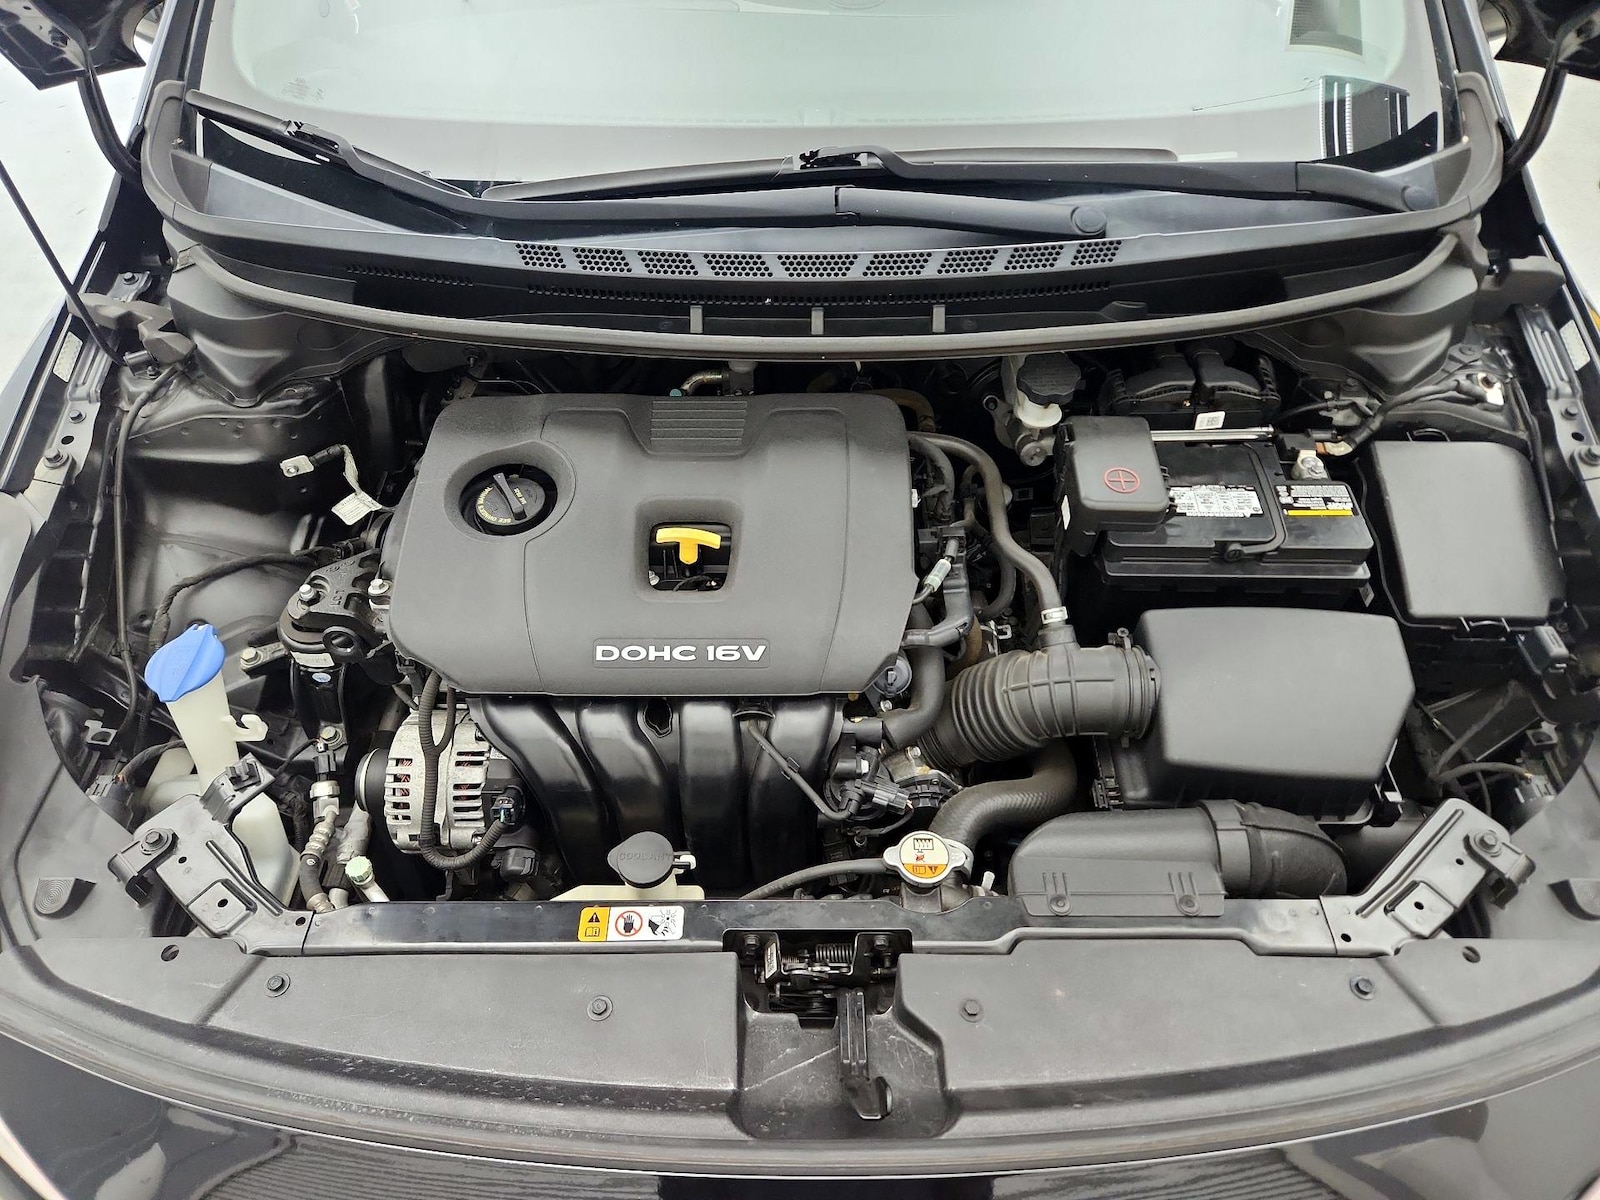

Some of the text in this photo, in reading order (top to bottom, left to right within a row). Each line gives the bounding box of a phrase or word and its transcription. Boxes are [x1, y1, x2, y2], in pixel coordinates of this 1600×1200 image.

[595, 645, 767, 661] DOHC 16V
[619, 851, 671, 861] COOLANT
